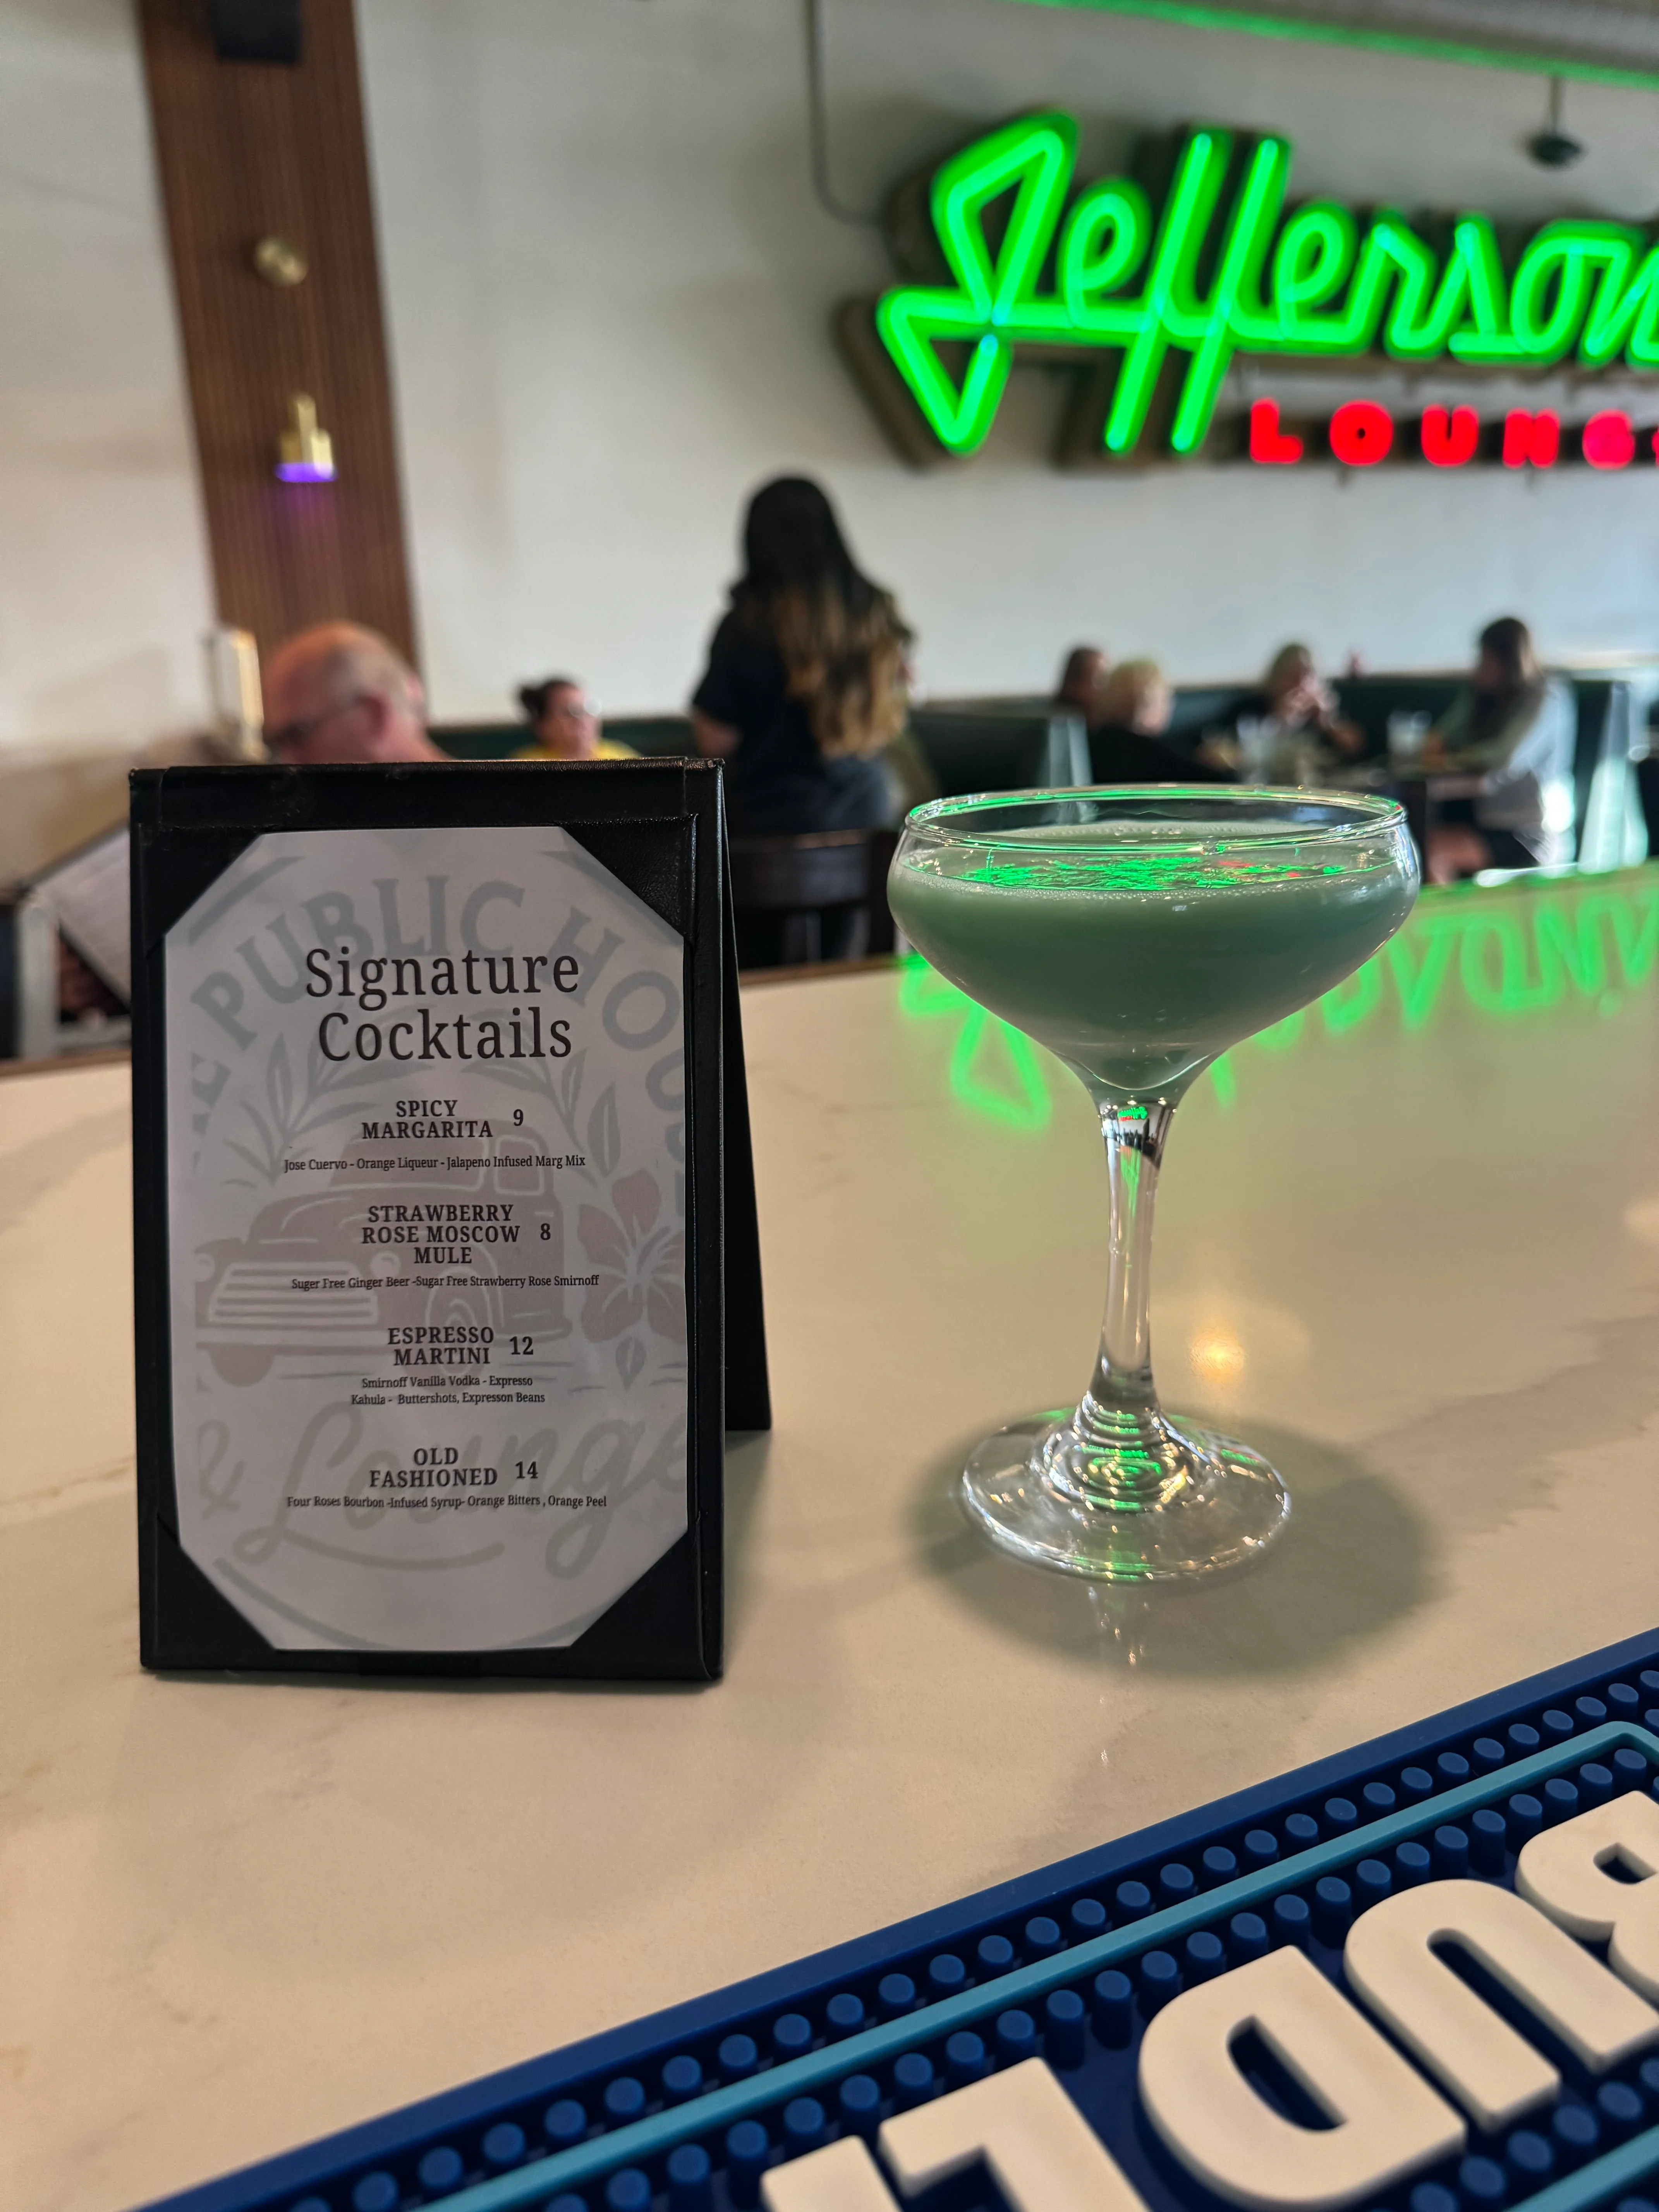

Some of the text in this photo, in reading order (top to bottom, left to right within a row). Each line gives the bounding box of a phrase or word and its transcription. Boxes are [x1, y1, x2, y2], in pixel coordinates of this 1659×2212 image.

[1249, 398, 1659, 469] LOUNG
[190, 874, 525, 1051] PUBLIC
[305, 946, 579, 1010] Signature
[318, 1008, 572, 1062] Cocktails
[395, 1099, 459, 1118] SPICY
[361, 1108, 524, 1140] MARGARITA 9
[283, 1159, 307, 1174] Jose
[308, 1159, 348, 1170] Cuervo
[356, 1158, 396, 1172] Orange
[397, 1156, 439, 1171] Liqueur
[446, 1156, 491, 1171] Jalapeno
[493, 1155, 533, 1168] Infused
[535, 1155, 563, 1170] Marg
[565, 1154, 586, 1166] Mix
[368, 1204, 514, 1223] STRAWBERRY
[361, 1223, 551, 1244] ROSE MOSCOW 8
[413, 1246, 472, 1264] MULE
[291, 1278, 321, 1292] Suger
[321, 1278, 346, 1289] Free
[348, 1277, 384, 1291] Ginger
[385, 1276, 411, 1288] Beer
[446, 1275, 468, 1287] Free
[470, 1275, 527, 1289] Strawberry
[528, 1275, 552, 1286] Rose
[553, 1274, 600, 1286] Smirnoff
[387, 1326, 494, 1345] ESPRESSO
[393, 1336, 534, 1366] MARTINI 12
[361, 1376, 409, 1389] Smirnoff
[409, 1375, 447, 1387] Vanilla
[448, 1374, 481, 1386] Vodka
[489, 1375, 533, 1389] Expresso
[350, 1394, 386, 1406] Kahula
[397, 1392, 460, 1405] Buttershots,
[461, 1392, 514, 1406] Expresson
[515, 1391, 546, 1403] Beans
[413, 1447, 459, 1467] OLD
[369, 1461, 539, 1489] FASHIONED 14
[286, 1496, 312, 1508] Four
[313, 1495, 342, 1507] Roses
[343, 1495, 385, 1508] Bourbon
[467, 1495, 505, 1510] Orange
[548, 1494, 584, 1510] Orange
[586, 1495, 607, 1507] Peel
